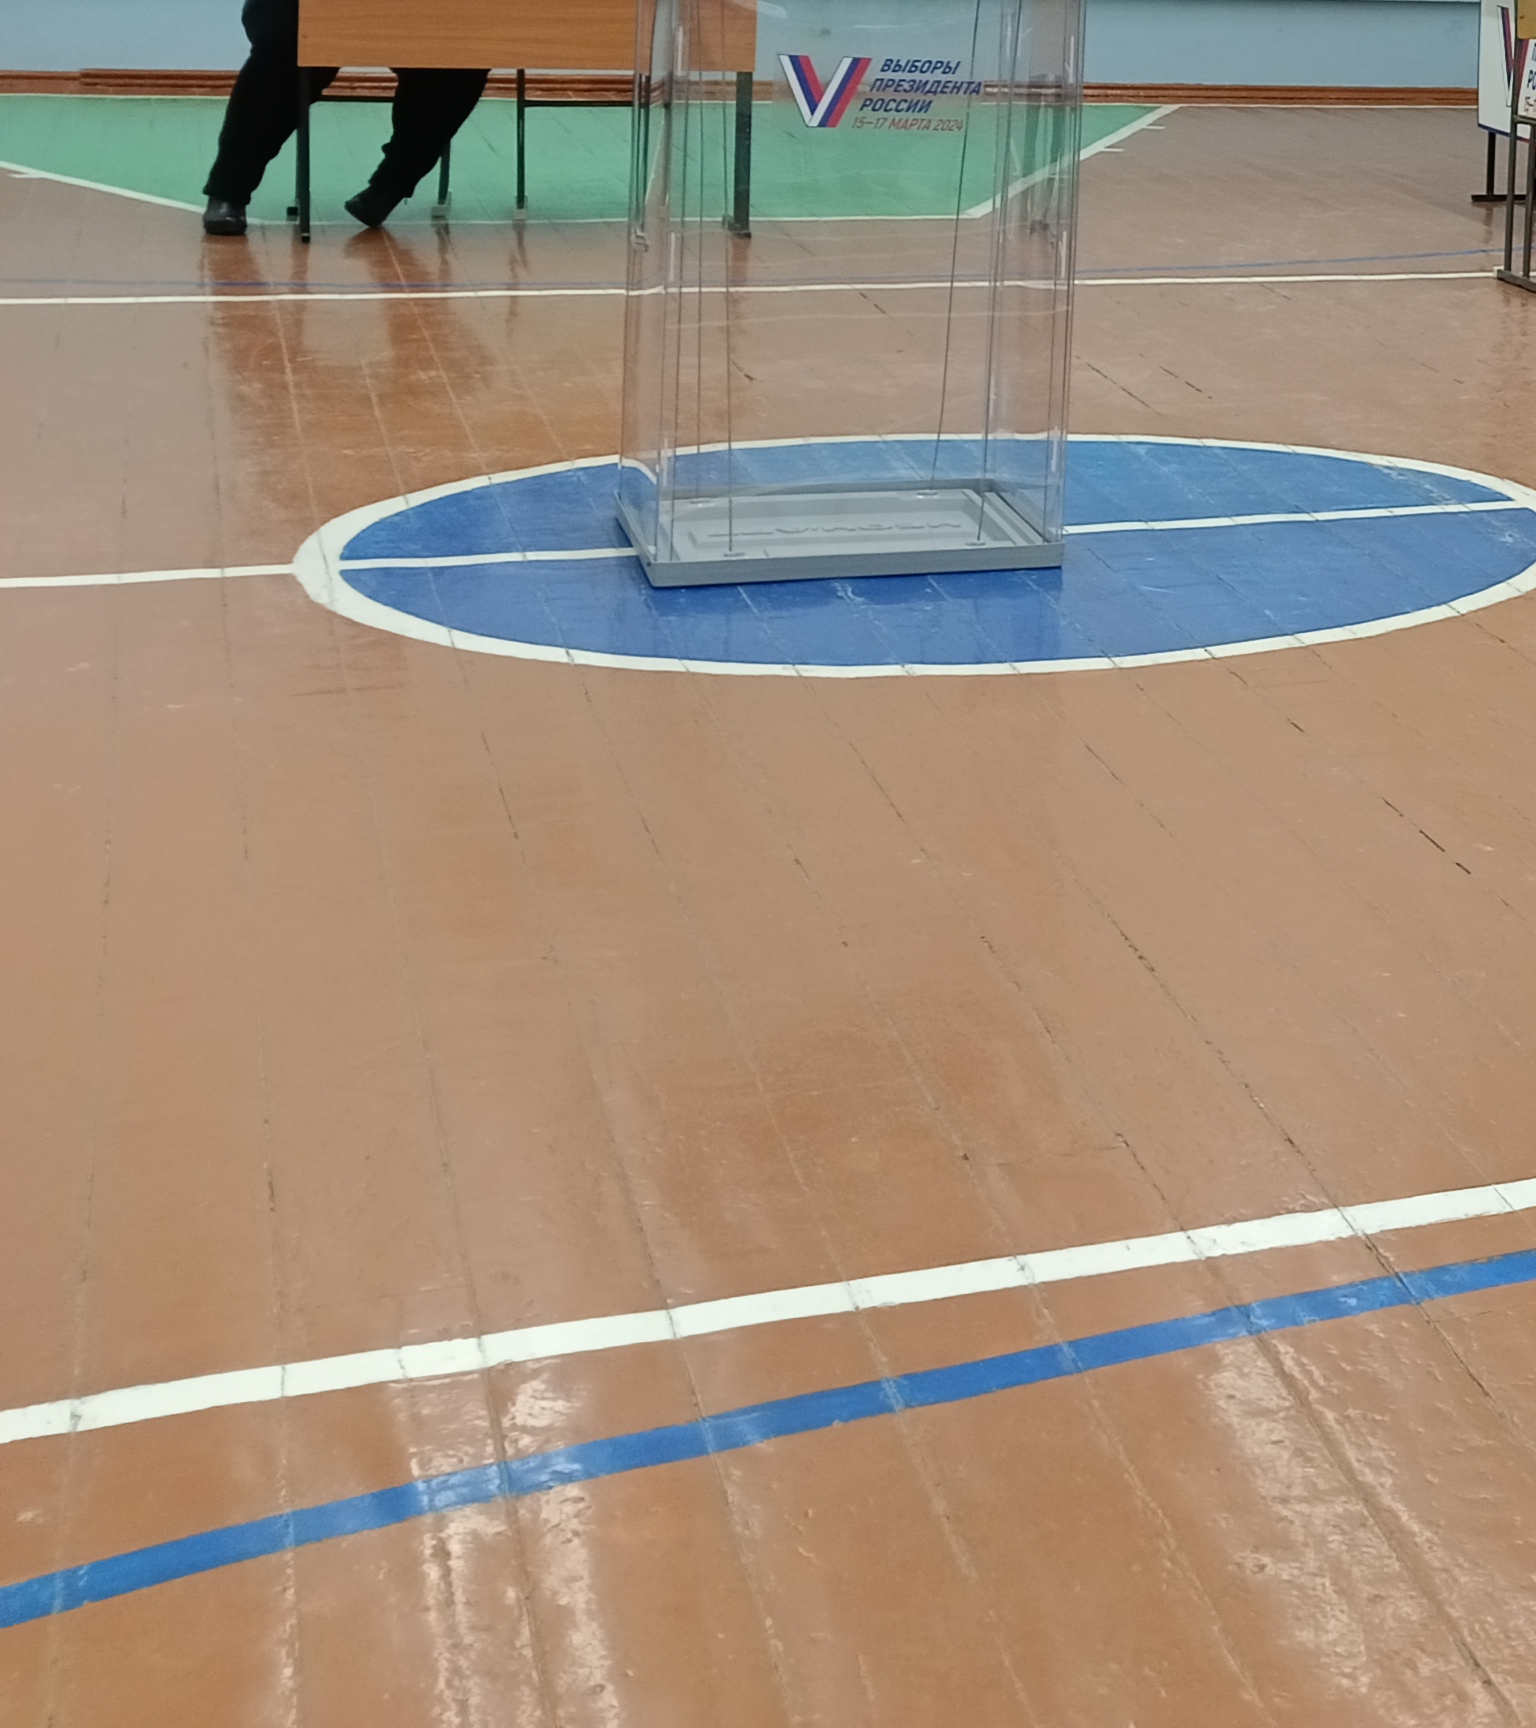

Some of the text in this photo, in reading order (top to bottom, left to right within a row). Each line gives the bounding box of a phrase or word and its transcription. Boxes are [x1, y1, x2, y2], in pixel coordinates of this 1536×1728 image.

[880, 58, 962, 75] ВЫБОРЫ
[870, 78, 984, 96] ПРЕЗИДЕНТА
[859, 98, 933, 114] РОССИИ
[888, 118, 932, 131] МАРТА
[933, 119, 964, 132] 2024
